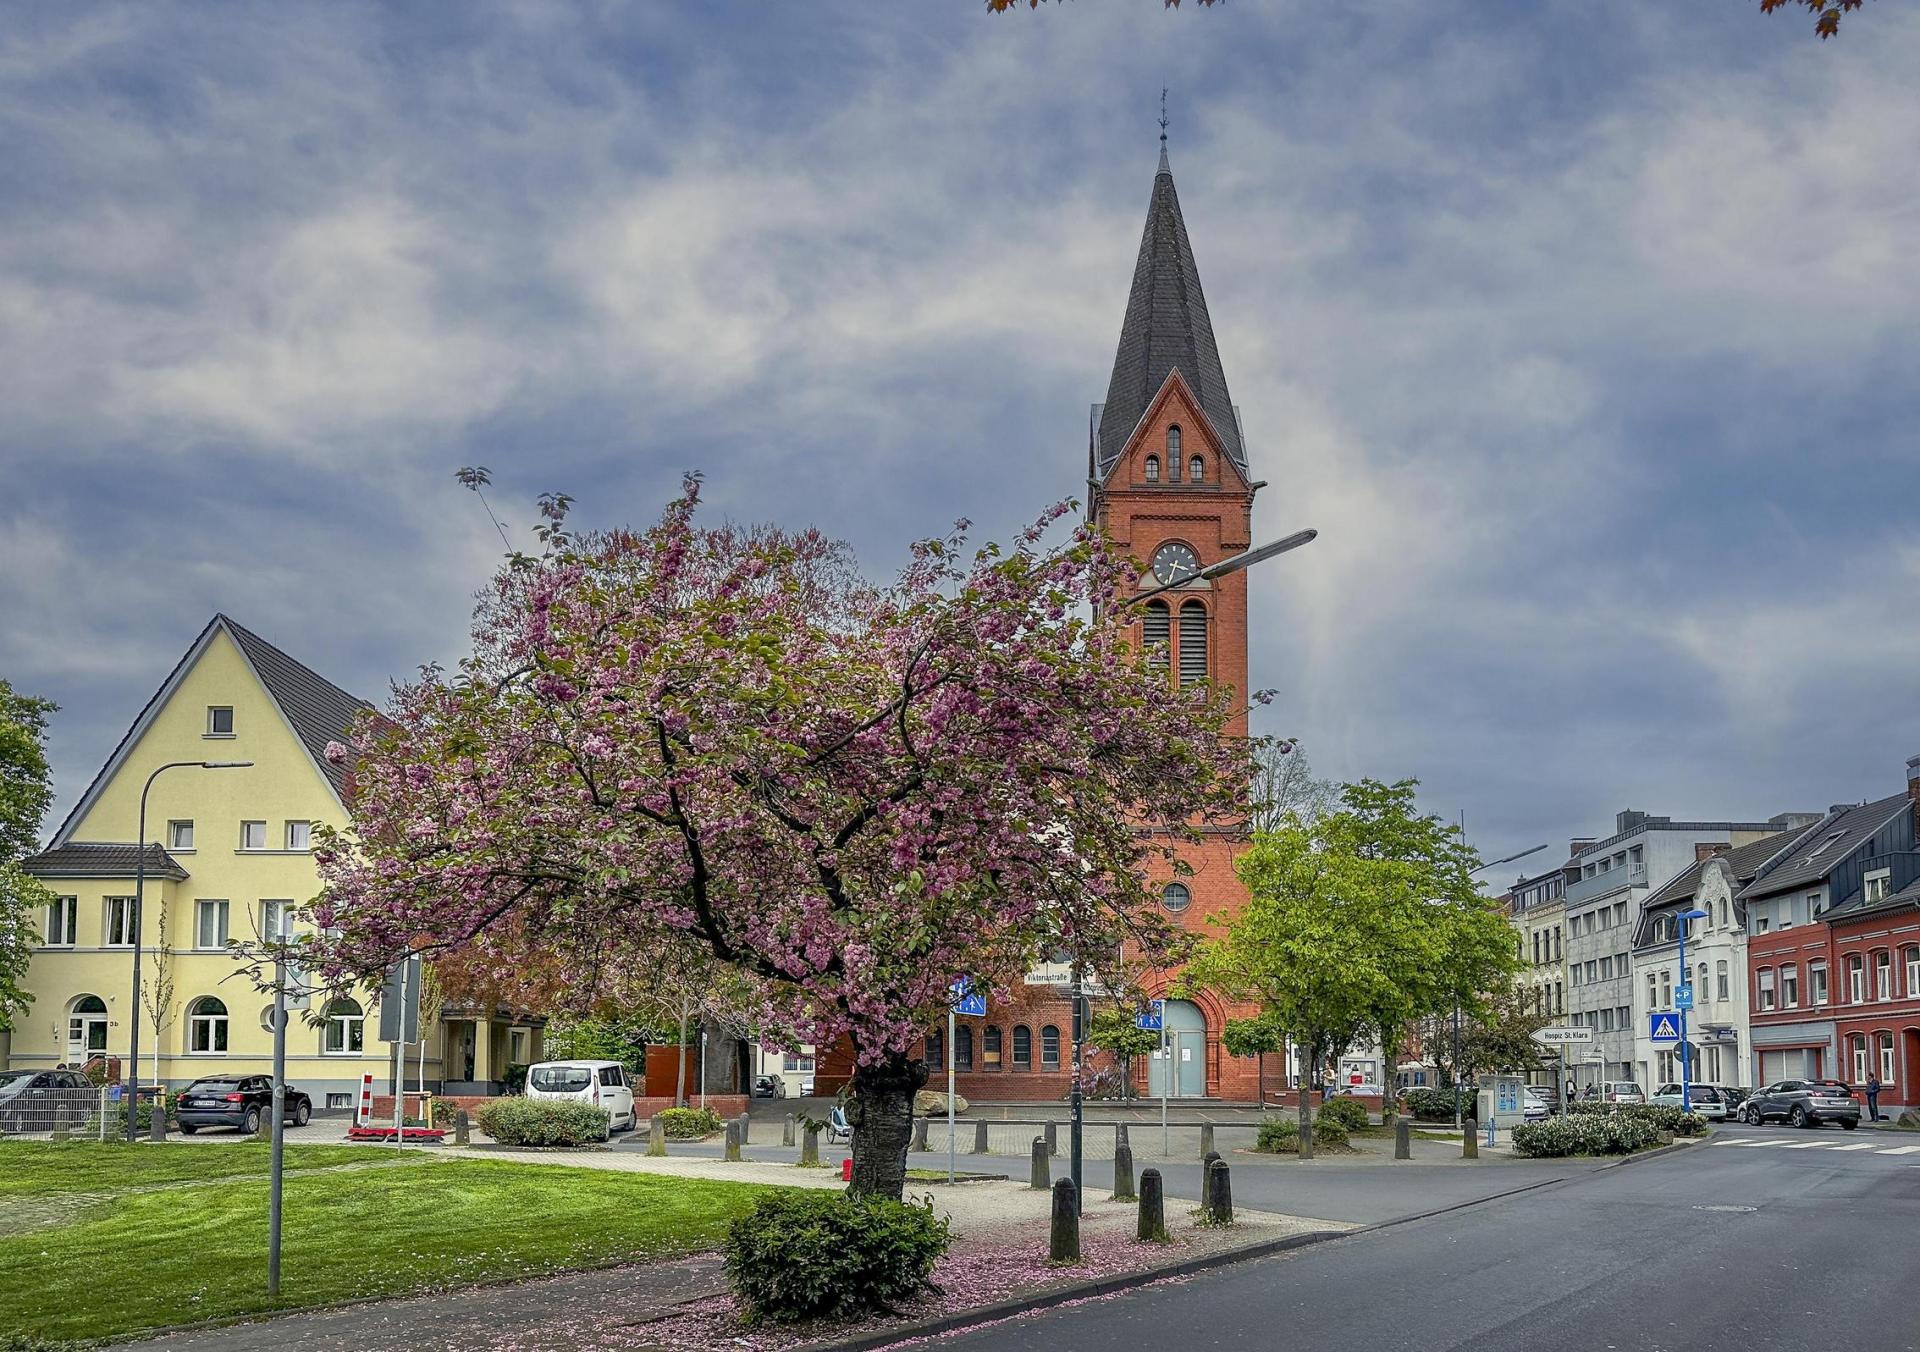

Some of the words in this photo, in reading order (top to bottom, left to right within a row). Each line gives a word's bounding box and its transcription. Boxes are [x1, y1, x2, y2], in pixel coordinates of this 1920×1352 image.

[1027, 973, 1068, 982] Viktoriastraße
[1683, 991, 1690, 999] P
[1544, 1032, 1563, 1040] Hospiz
[1573, 1031, 1588, 1039] Klara
